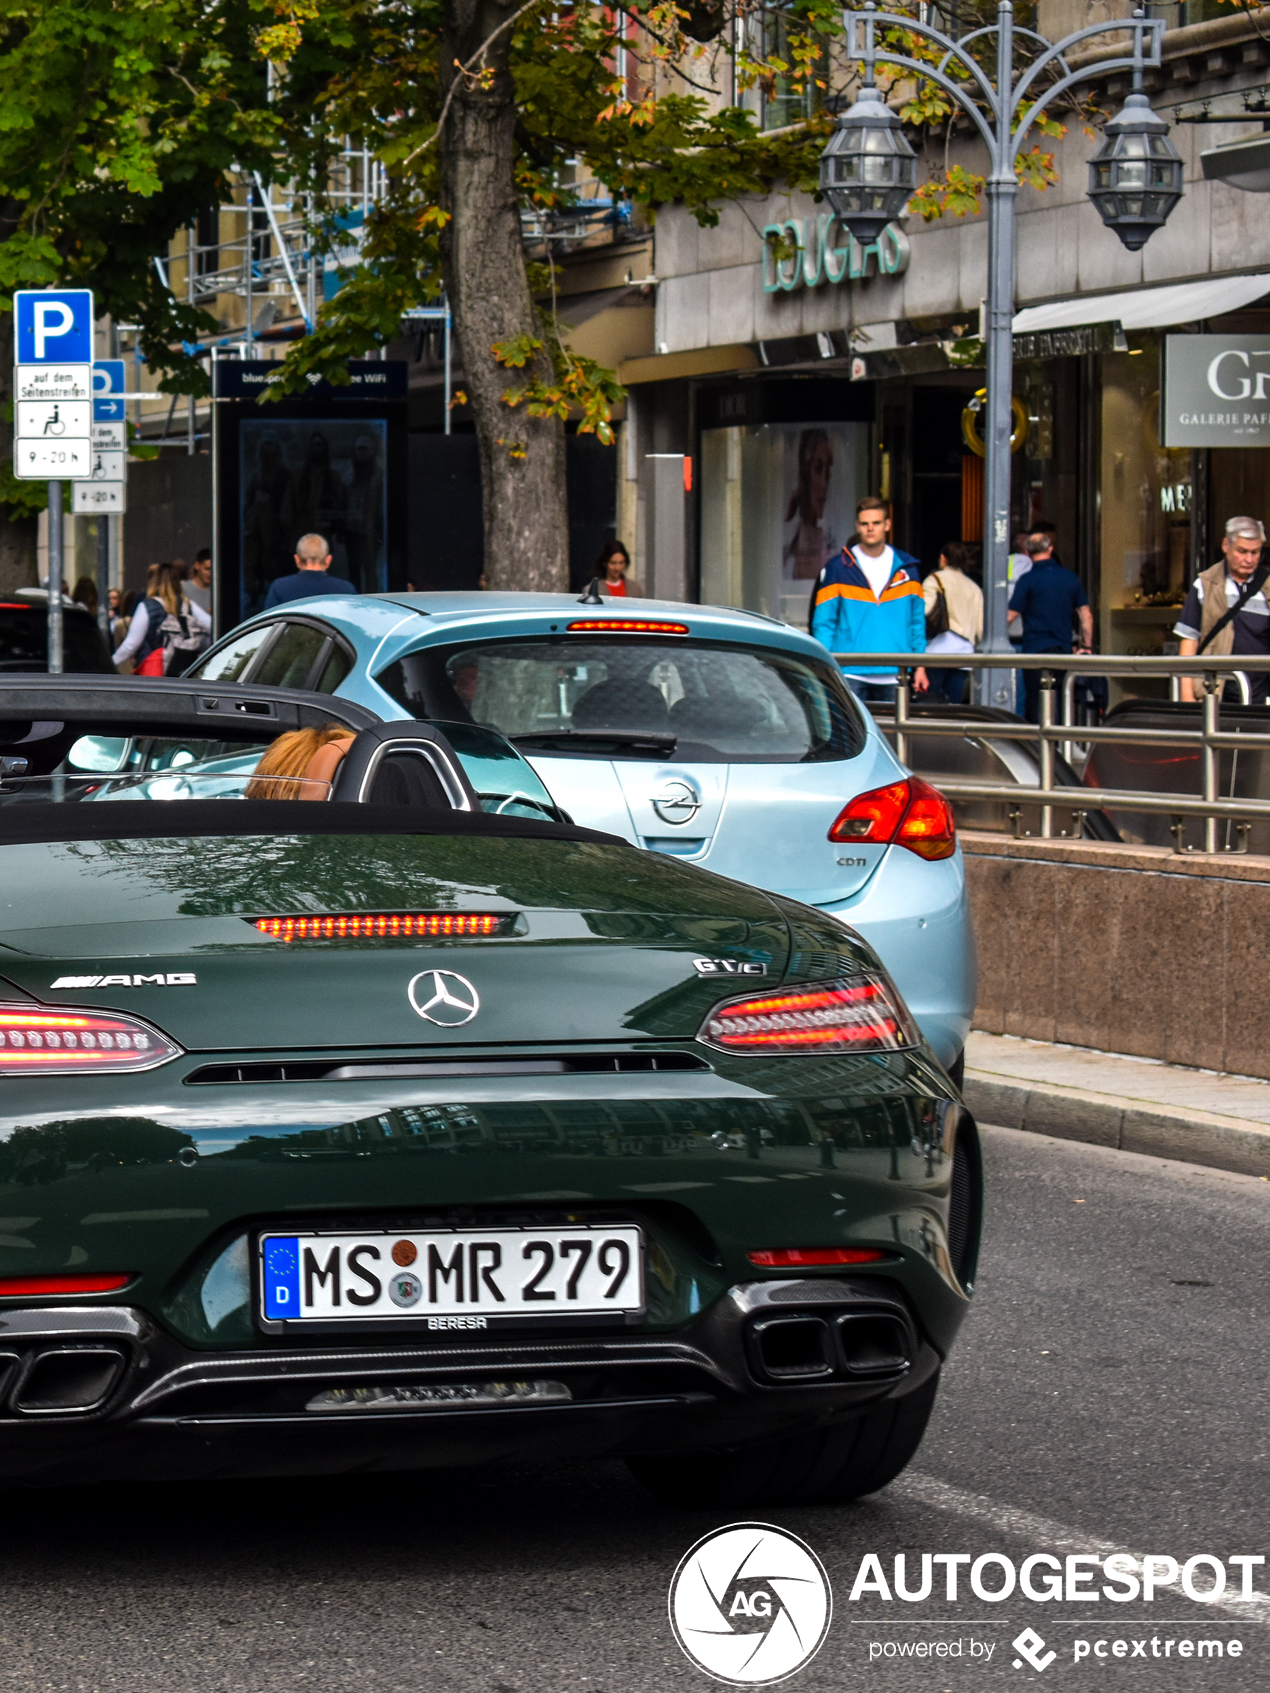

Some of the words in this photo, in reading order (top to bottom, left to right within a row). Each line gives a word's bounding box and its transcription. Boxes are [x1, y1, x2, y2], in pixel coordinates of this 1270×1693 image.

[33, 301, 74, 359] P
[33, 372, 48, 383] auf
[53, 372, 73, 383] dem
[364, 373, 386, 383] WiFi
[21, 386, 86, 397] Seitenstreifen
[1179, 413, 1240, 426] GALERIE
[29, 451, 36, 463] 9
[51, 451, 66, 463] 20
[837, 857, 867, 867] CDTI
[97, 973, 197, 987] AMG
[302, 1244, 382, 1307] MS
[428, 1241, 506, 1304] MR
[521, 1238, 631, 1301] 279
[275, 1286, 290, 1304] D
[428, 1317, 488, 1331] BERESA
